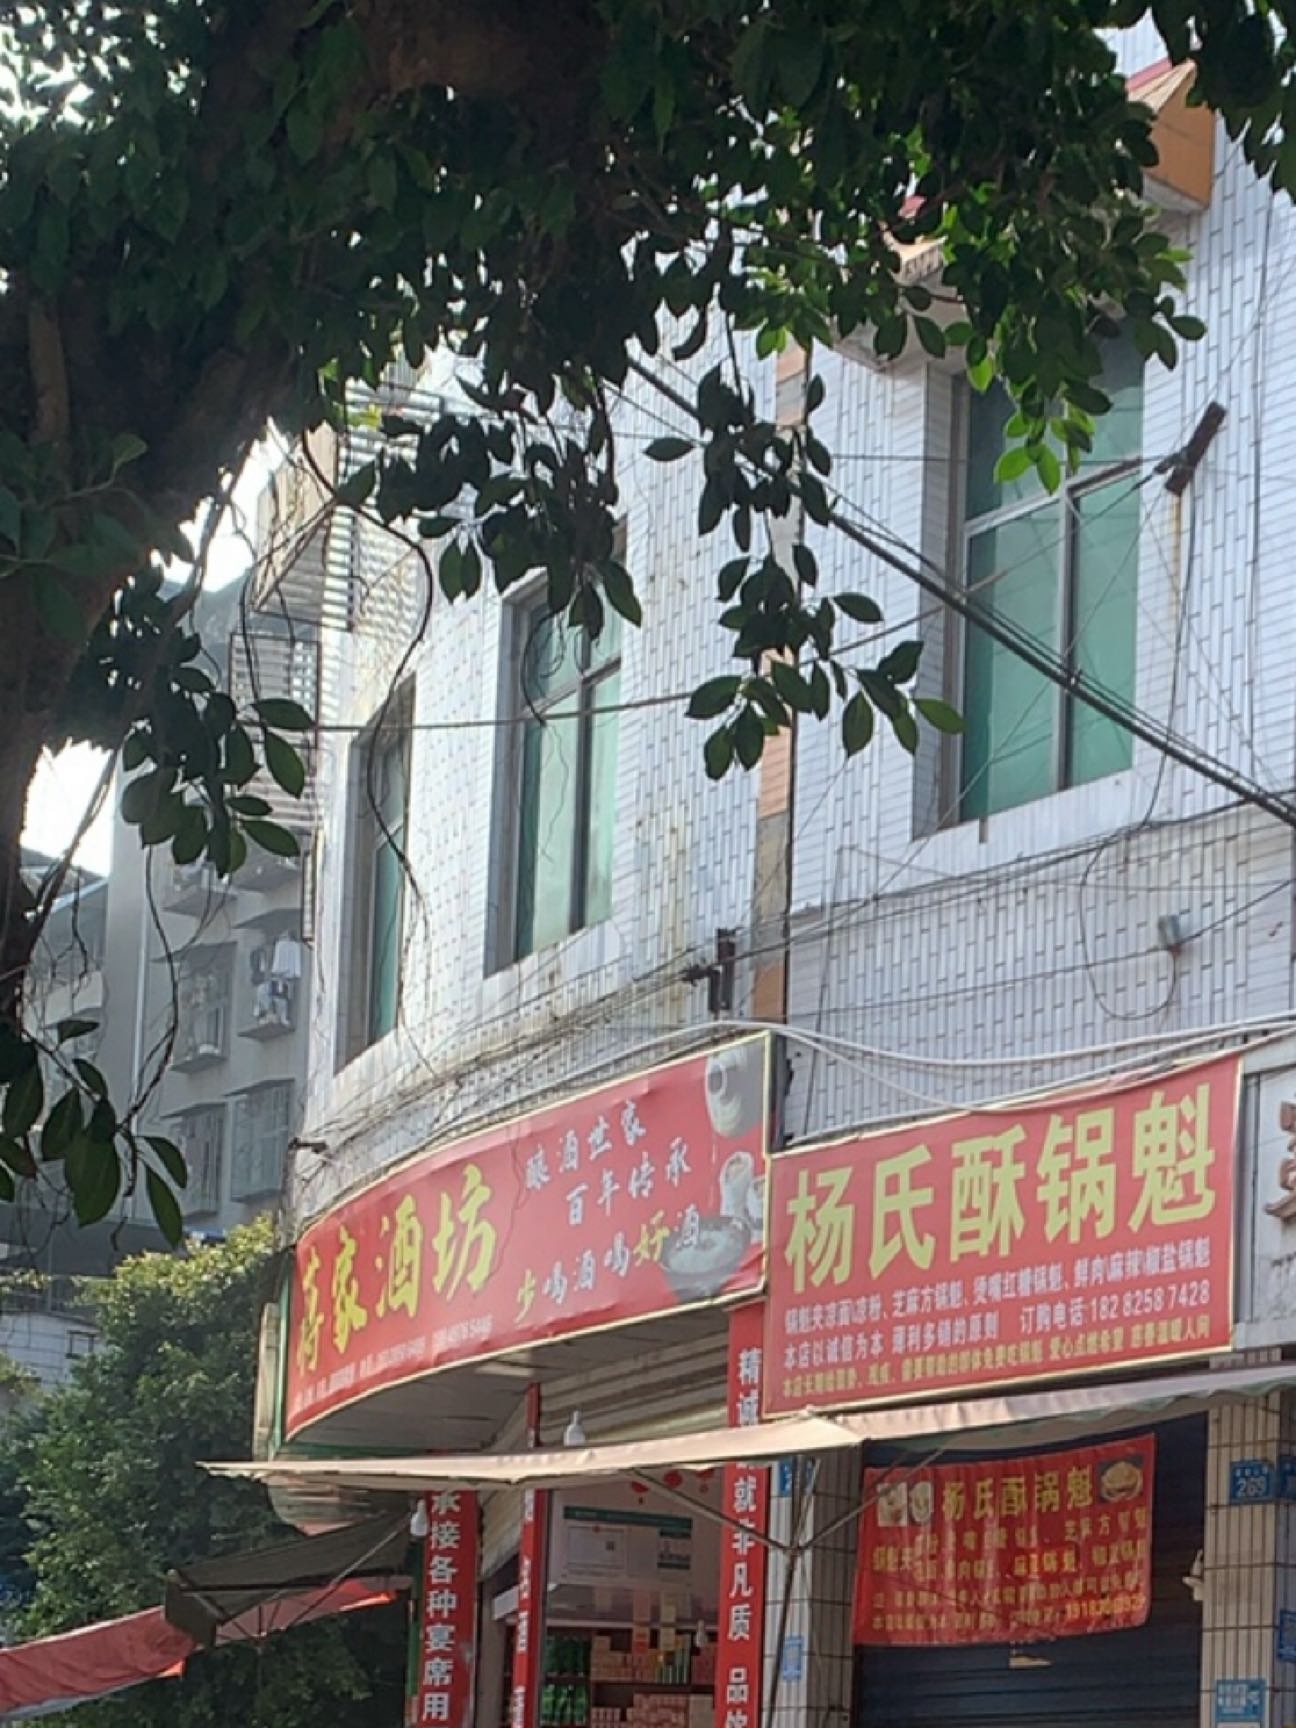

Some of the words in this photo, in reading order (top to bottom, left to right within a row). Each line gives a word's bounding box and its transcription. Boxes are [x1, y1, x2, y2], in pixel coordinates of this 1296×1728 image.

[526, 1098, 647, 1190] 酿酒世家
[566, 1136, 691, 1226] 百年传承
[784, 1082, 1216, 1294] 杨氏酥锅魁
